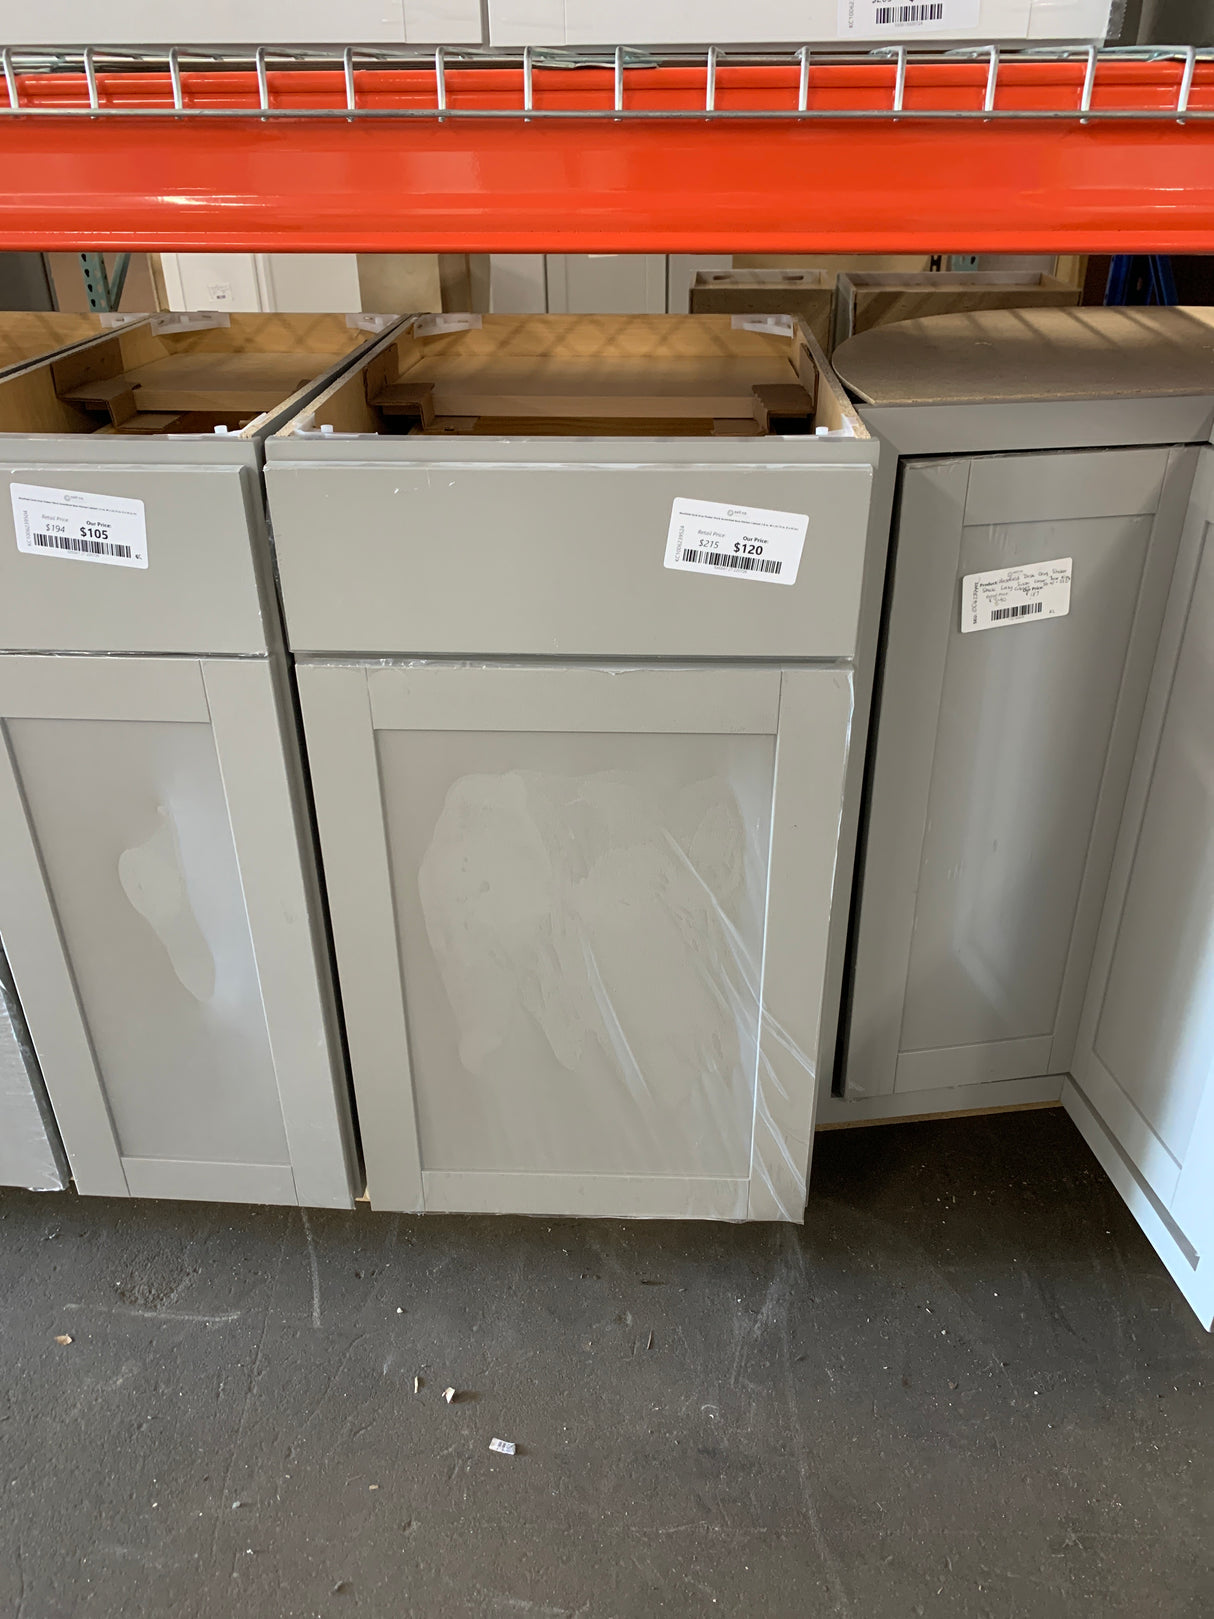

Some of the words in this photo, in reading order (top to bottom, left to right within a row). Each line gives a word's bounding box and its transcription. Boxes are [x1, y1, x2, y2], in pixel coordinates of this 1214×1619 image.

[41, 513, 55, 521] Retail
[45, 523, 65, 533] $194
[80, 526, 109, 540] $105
[697, 529, 712, 537] Retail
[713, 530, 725, 538] Price
[699, 539, 719, 549] $215
[753, 536, 768, 544] Price:
[733, 542, 763, 556] $120
